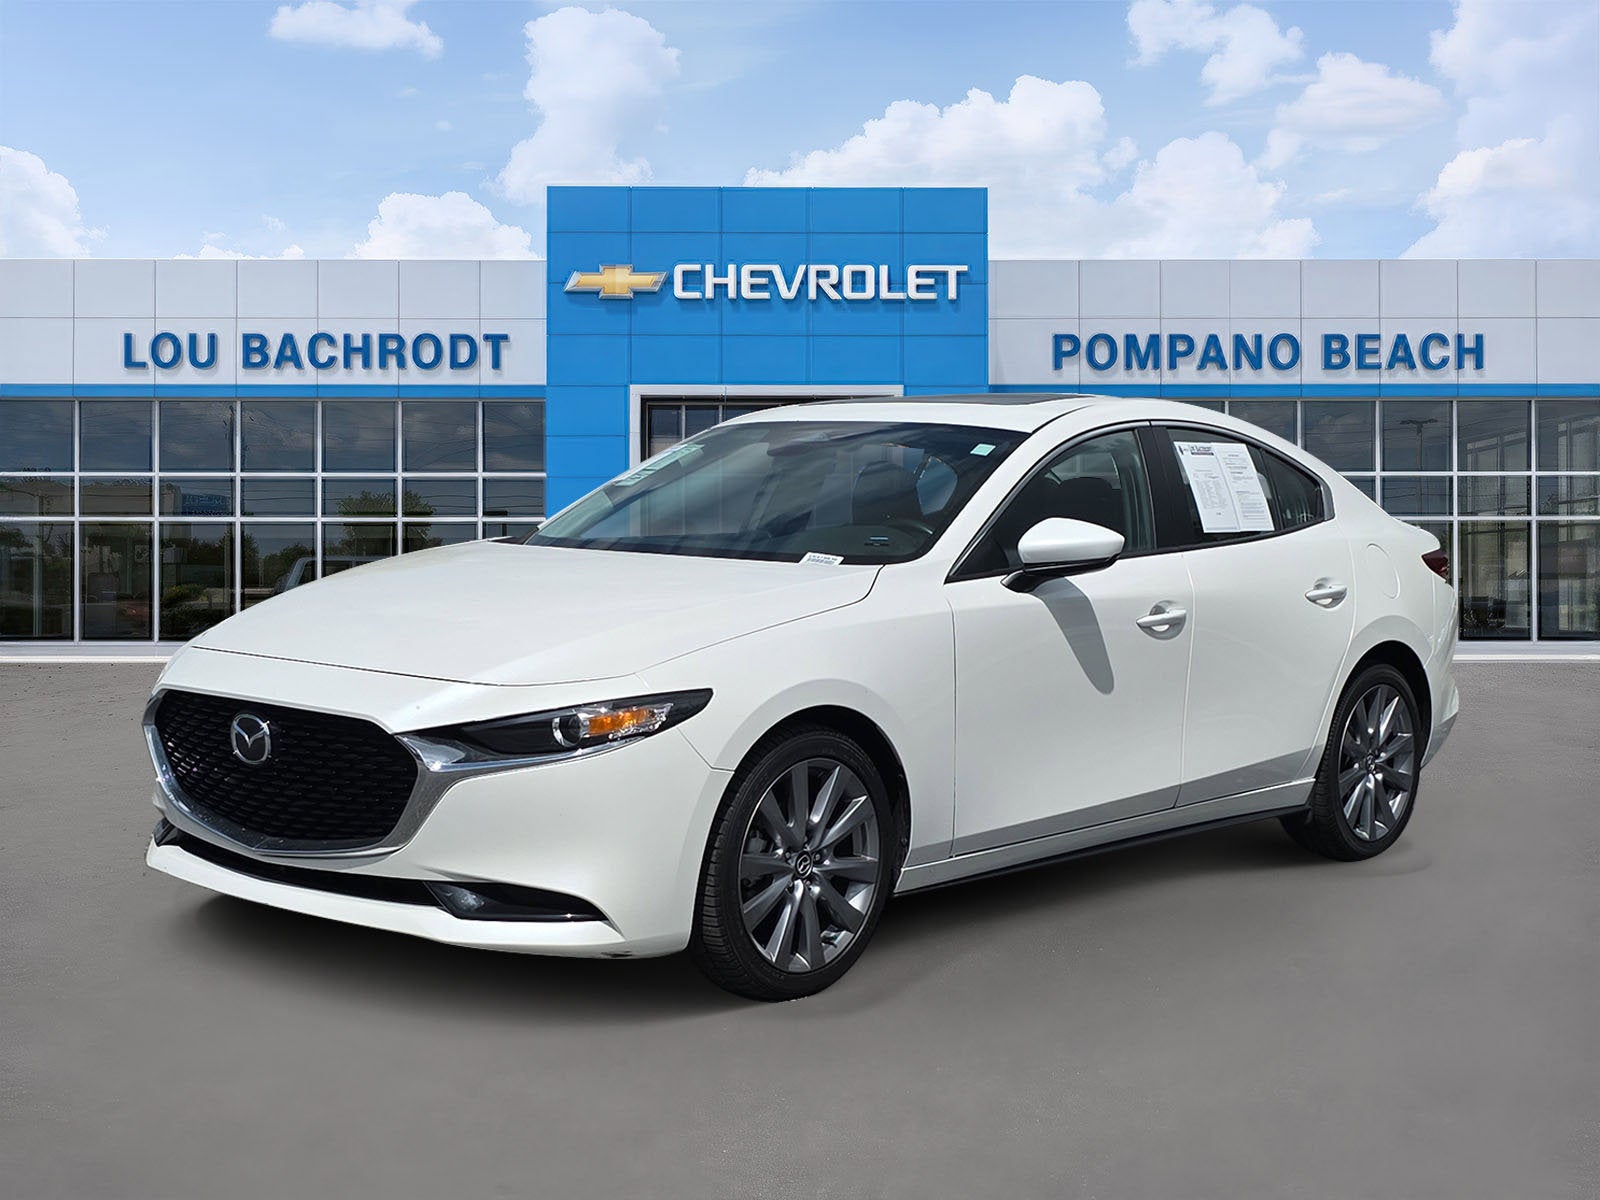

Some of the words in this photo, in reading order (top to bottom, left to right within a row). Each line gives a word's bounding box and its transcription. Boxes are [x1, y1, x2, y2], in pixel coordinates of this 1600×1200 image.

[672, 264, 968, 300] CHEVROLET
[123, 332, 219, 370] LOU
[242, 332, 510, 370] BACHRODT
[1052, 333, 1301, 371] POMPANO
[1321, 333, 1485, 371] BEACH
